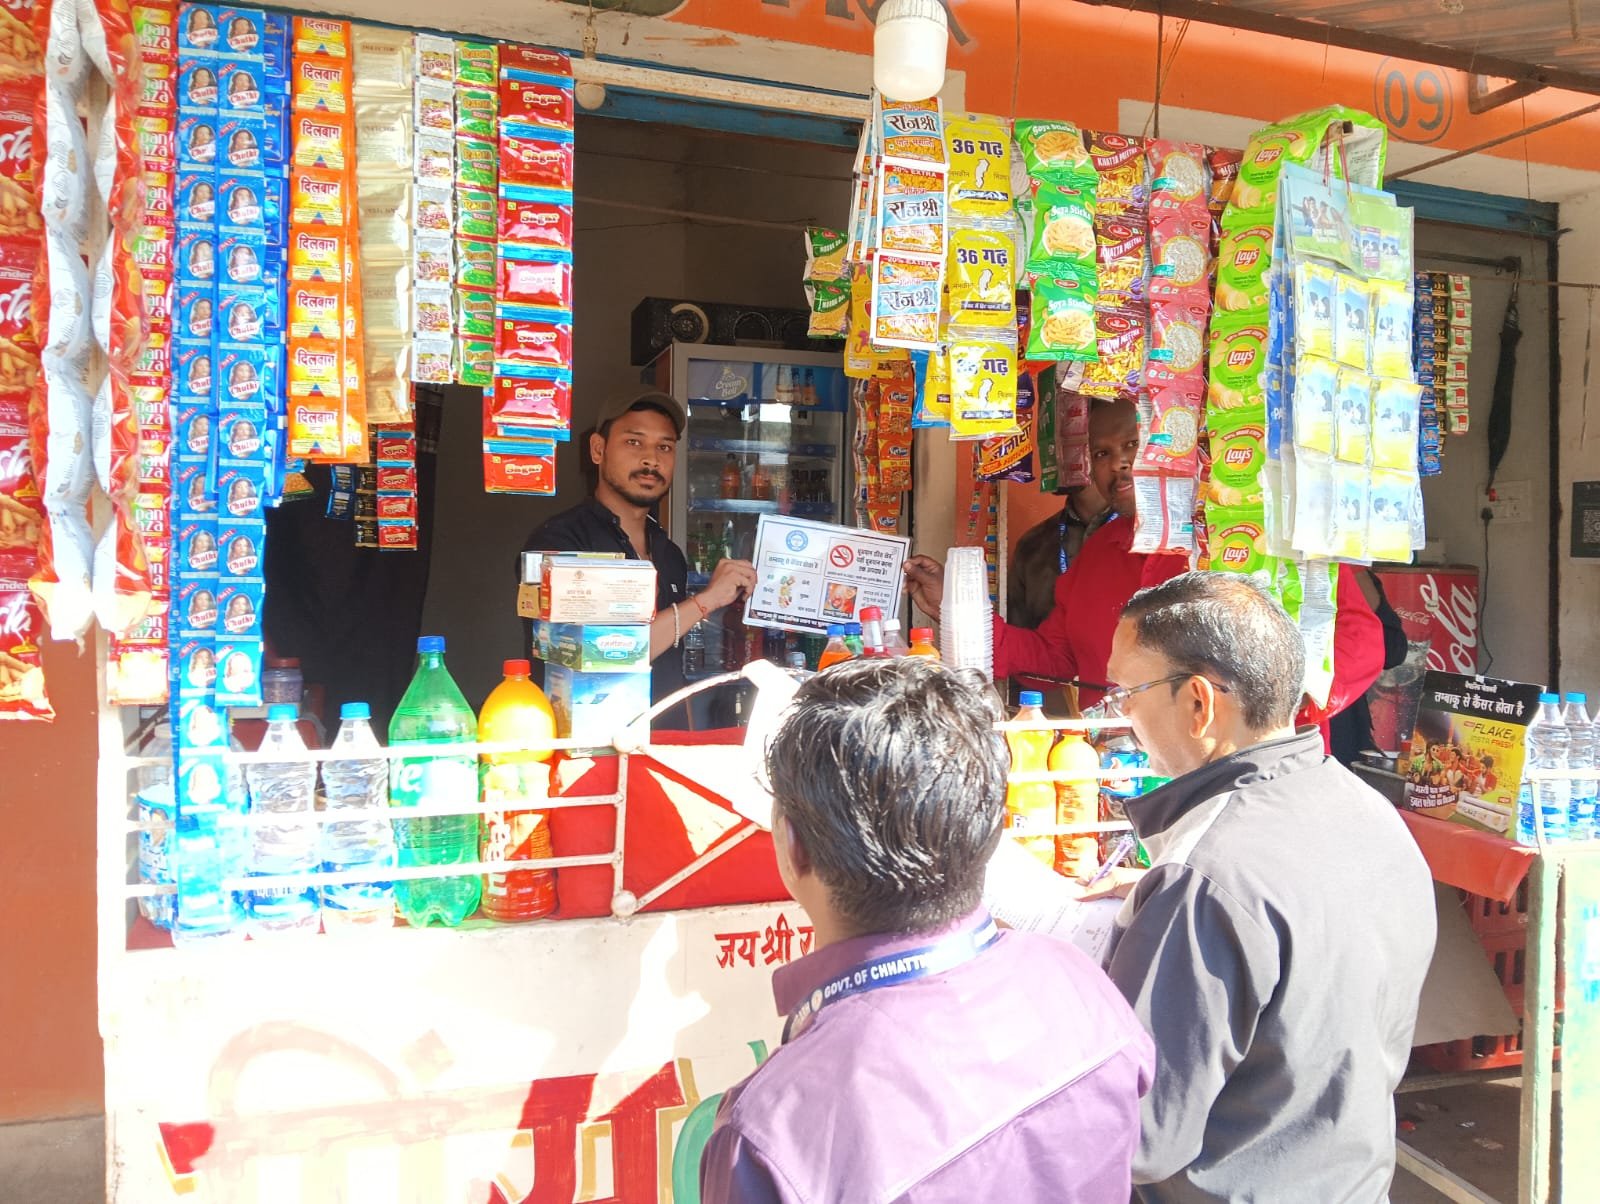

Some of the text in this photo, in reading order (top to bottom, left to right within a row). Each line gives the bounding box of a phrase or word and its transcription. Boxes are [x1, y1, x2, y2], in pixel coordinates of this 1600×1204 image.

[303, 63, 340, 81] दिलबाग
[1384, 70, 1443, 130] 09
[302, 120, 340, 138] दिलबाग
[887, 114, 937, 132] राजश्री
[952, 139, 975, 154] 36
[1256, 148, 1282, 162] Lay's
[301, 177, 338, 194] दिलबाग
[888, 198, 939, 219] राजश्री
[299, 234, 336, 251] दिलबाग
[957, 248, 979, 265] 36
[1235, 248, 1260, 265] Lay's
[298, 291, 335, 308] दिलबाग
[881, 288, 935, 310] राजश्री
[297, 350, 335, 366] दिलबाग
[1228, 349, 1255, 366] Lay's
[715, 379, 741, 391] Cream
[297, 408, 335, 424] दिलबाग
[1225, 448, 1253, 463] Lay's
[1223, 547, 1250, 562] Lay's
[1434, 691, 1525, 717] तम्बाकू से कैंसर होता है
[1473, 723, 1513, 739] FLAKE
[715, 932, 761, 969] जय
[761, 913, 795, 964] श्री
[823, 977, 853, 998] GOVT.
[854, 969, 868, 985] OF
